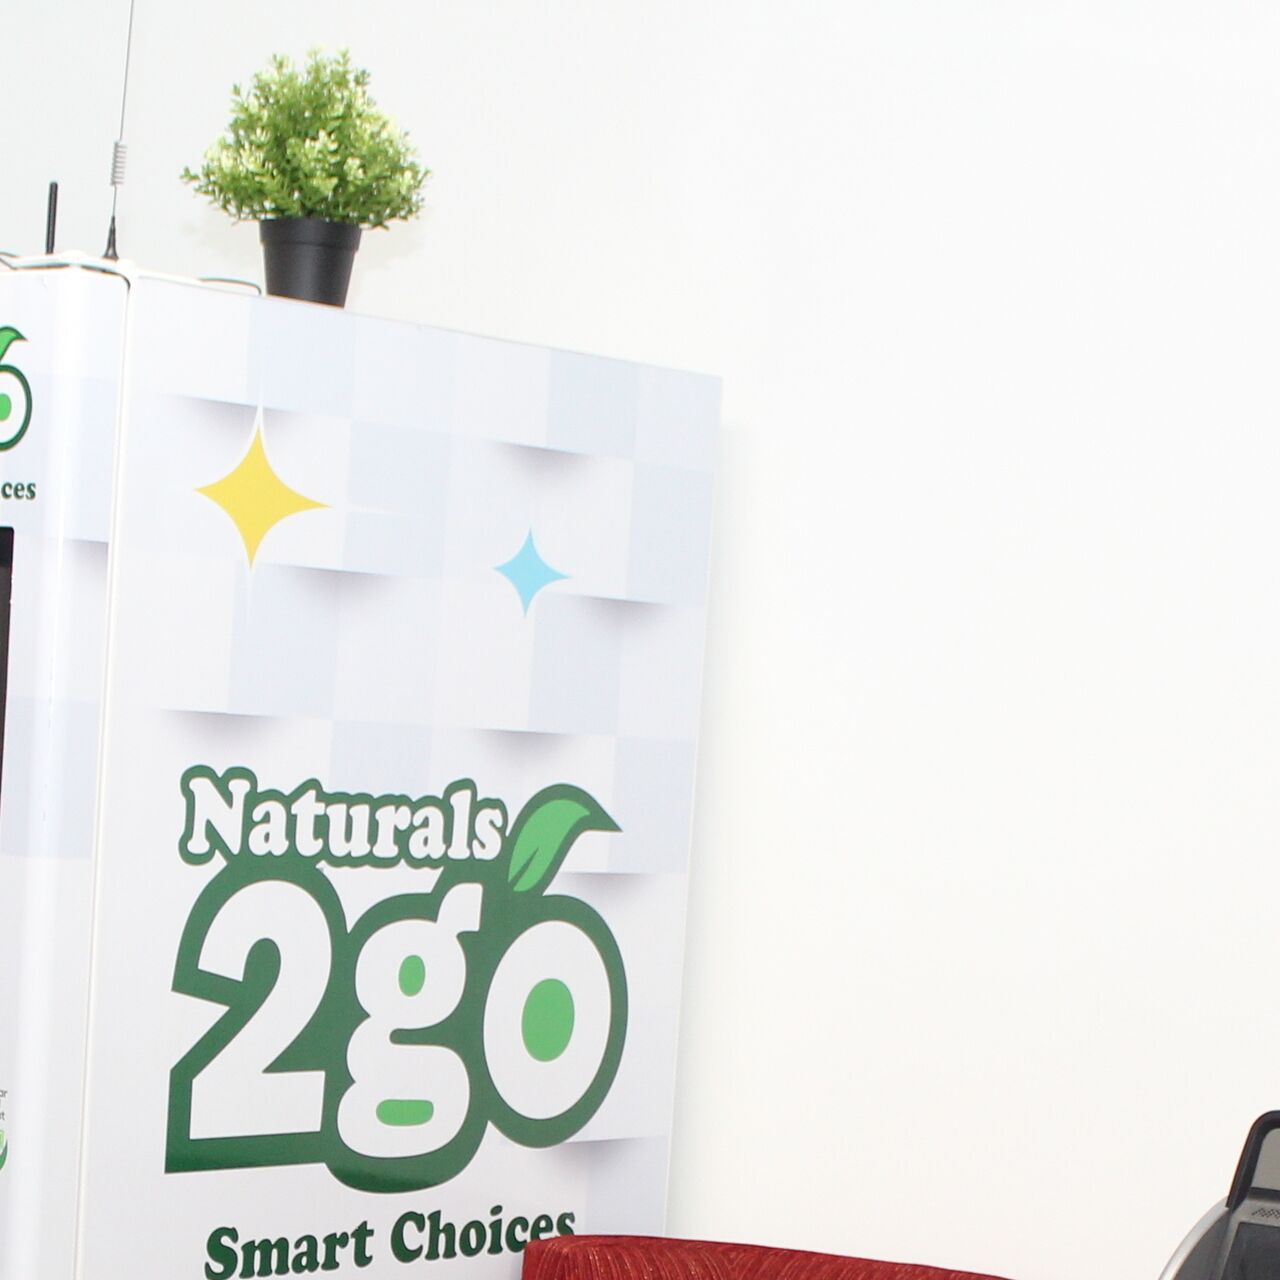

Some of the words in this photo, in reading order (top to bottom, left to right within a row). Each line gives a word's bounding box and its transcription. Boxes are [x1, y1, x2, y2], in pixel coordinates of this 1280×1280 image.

[179, 765, 508, 869] Naturals
[165, 866, 628, 1194] 2go
[391, 1205, 576, 1263] Choices
